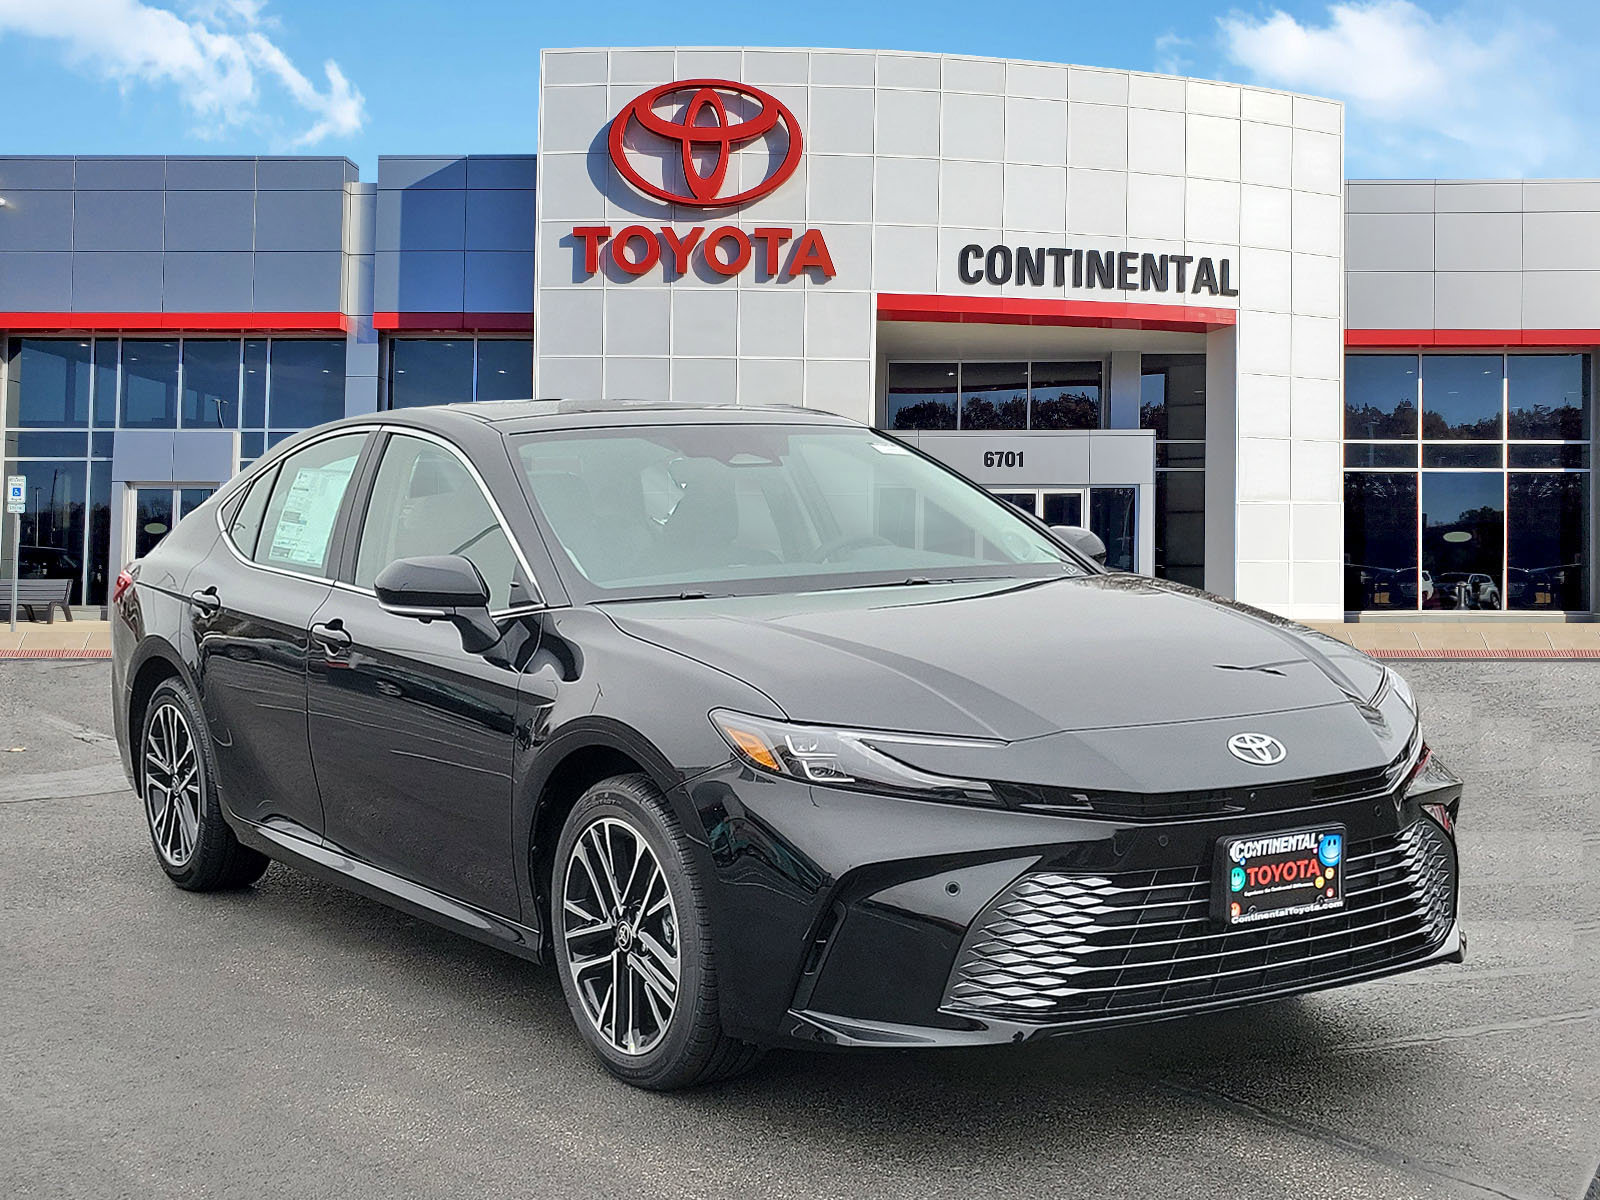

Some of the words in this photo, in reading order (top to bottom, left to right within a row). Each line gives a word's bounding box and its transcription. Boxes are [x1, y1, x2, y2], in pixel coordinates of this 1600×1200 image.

[573, 225, 836, 277] TOYOTA
[959, 244, 1239, 296] CONTINENTAL
[983, 451, 1024, 468] 6701
[1230, 833, 1318, 862] CONTINENTAL
[1246, 858, 1321, 887] TOYOTA
[1231, 900, 1343, 924] ContinentalToyota.com
